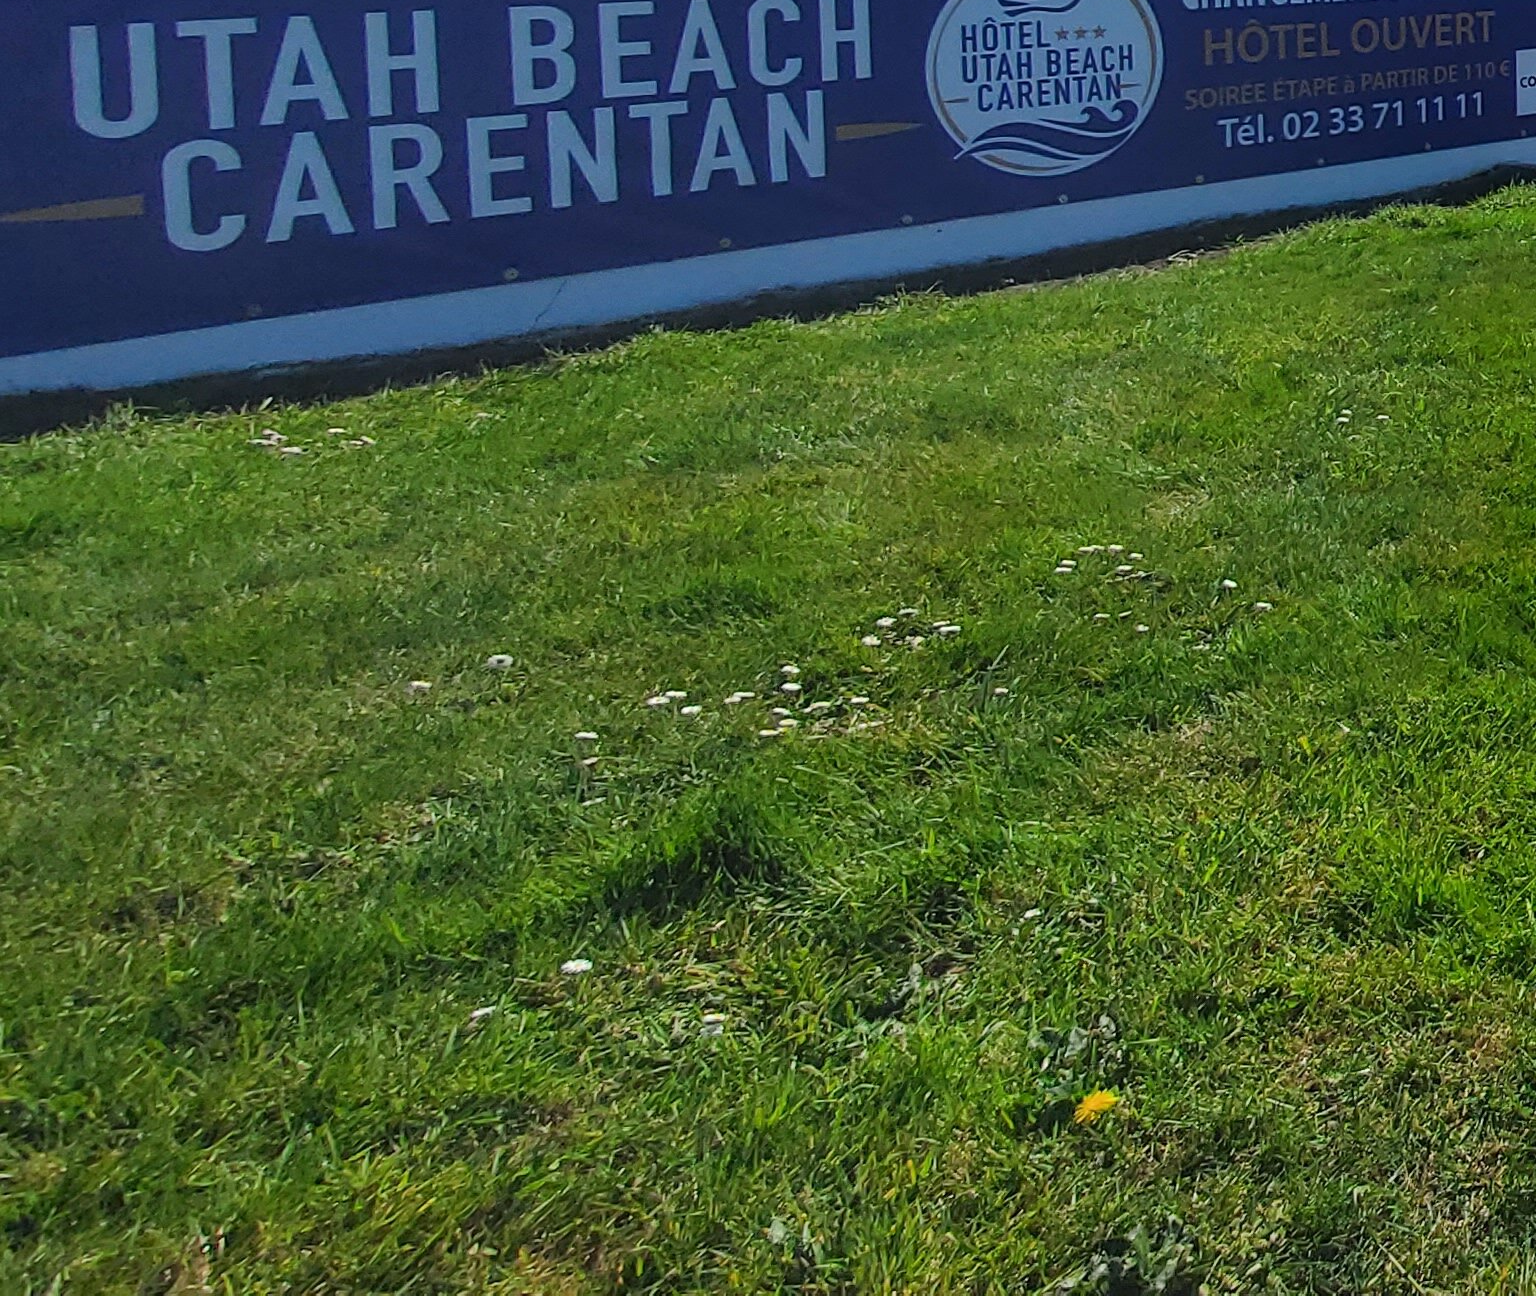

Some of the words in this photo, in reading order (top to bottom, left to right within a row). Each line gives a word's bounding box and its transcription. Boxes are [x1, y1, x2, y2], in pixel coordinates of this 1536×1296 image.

[961, 17, 1051, 53] HÔTEL
[1203, 19, 1341, 66] HÔTEL
[1351, 10, 1497, 54] OUVERT
[69, 8, 441, 139] UTAH
[961, 52, 1032, 83] UTAH
[1046, 44, 1133, 77] BEACH
[1361, 68, 1429, 92] PARTIR
[1433, 64, 1458, 85] DE
[1464, 60, 1496, 80] 110
[1499, 59, 1512, 78] €
[977, 73, 1121, 112] CARENTAN
[1217, 115, 1275, 148] Tél.
[1282, 110, 1321, 141] 02
[1328, 105, 1365, 136] 33
[1372, 101, 1405, 129] 71
[1415, 97, 1445, 124] 11
[1456, 91, 1484, 119] 11
[161, 89, 826, 252] CARENTAN
